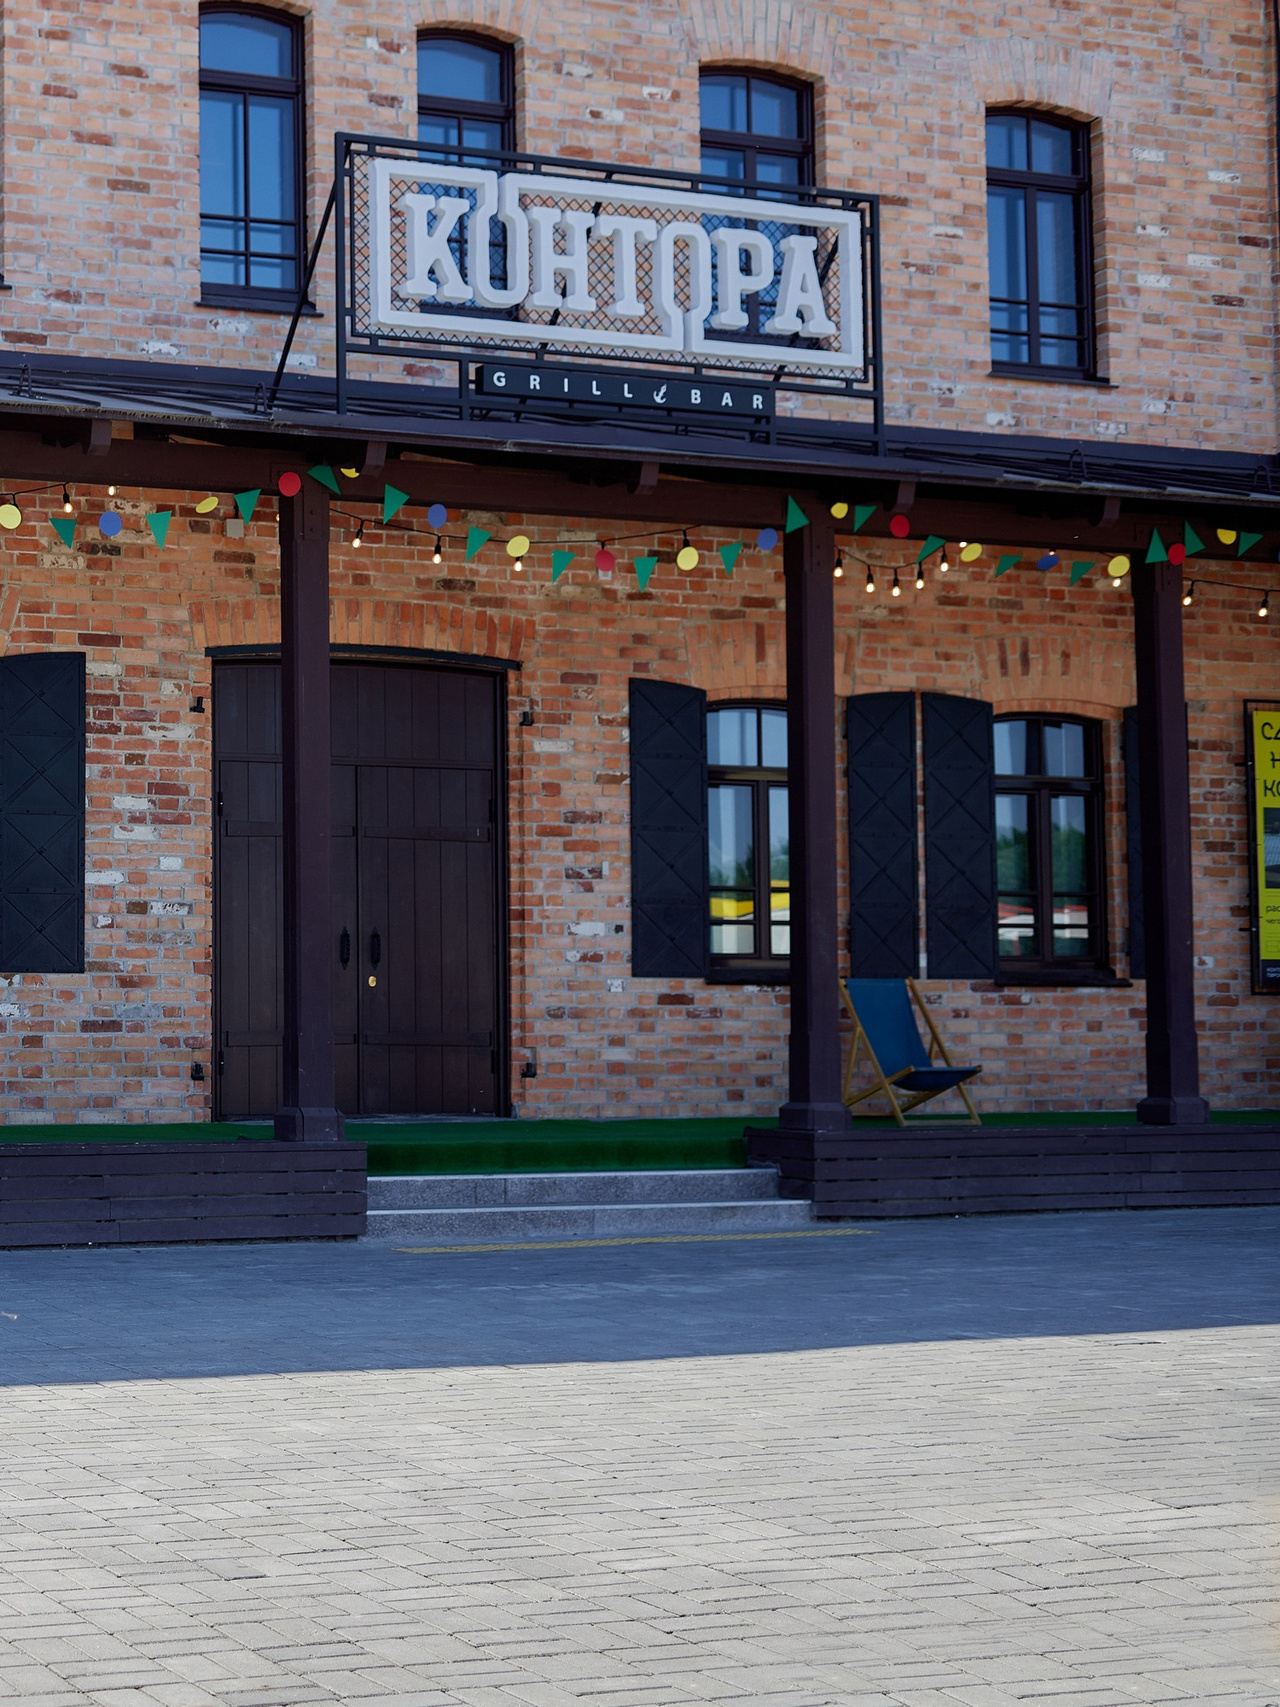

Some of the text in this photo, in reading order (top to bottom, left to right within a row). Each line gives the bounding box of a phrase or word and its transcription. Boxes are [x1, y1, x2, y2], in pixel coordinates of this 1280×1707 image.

[397, 191, 837, 338] КОНТОРА
[492, 370, 764, 410] GRILL BAR
